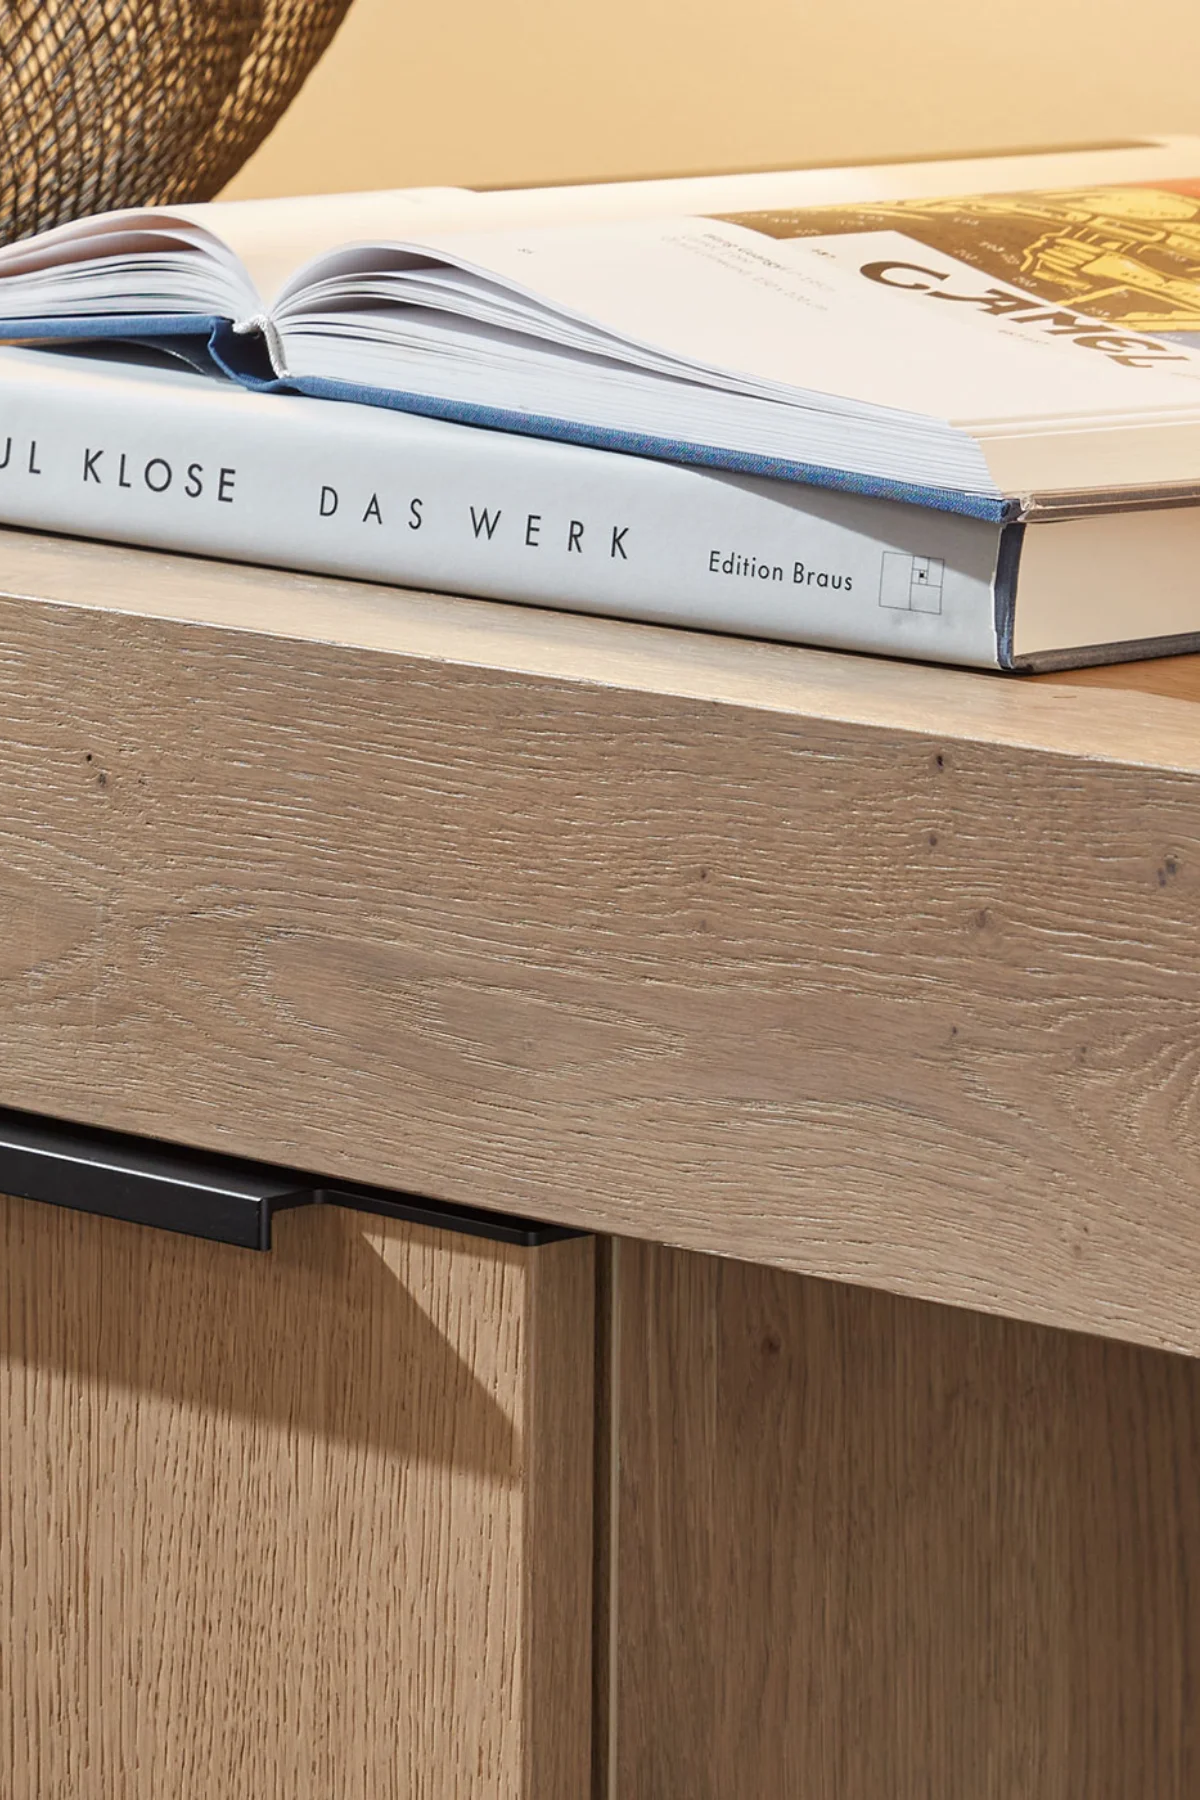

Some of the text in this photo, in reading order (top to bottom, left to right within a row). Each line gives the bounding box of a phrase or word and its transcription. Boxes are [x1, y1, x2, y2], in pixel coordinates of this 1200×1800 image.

[859, 260, 1190, 368] CAMEL
[82, 448, 236, 503] KLOSE
[318, 485, 423, 531] DAS
[469, 505, 630, 561] WERK
[708, 550, 853, 592] Edition Braus
